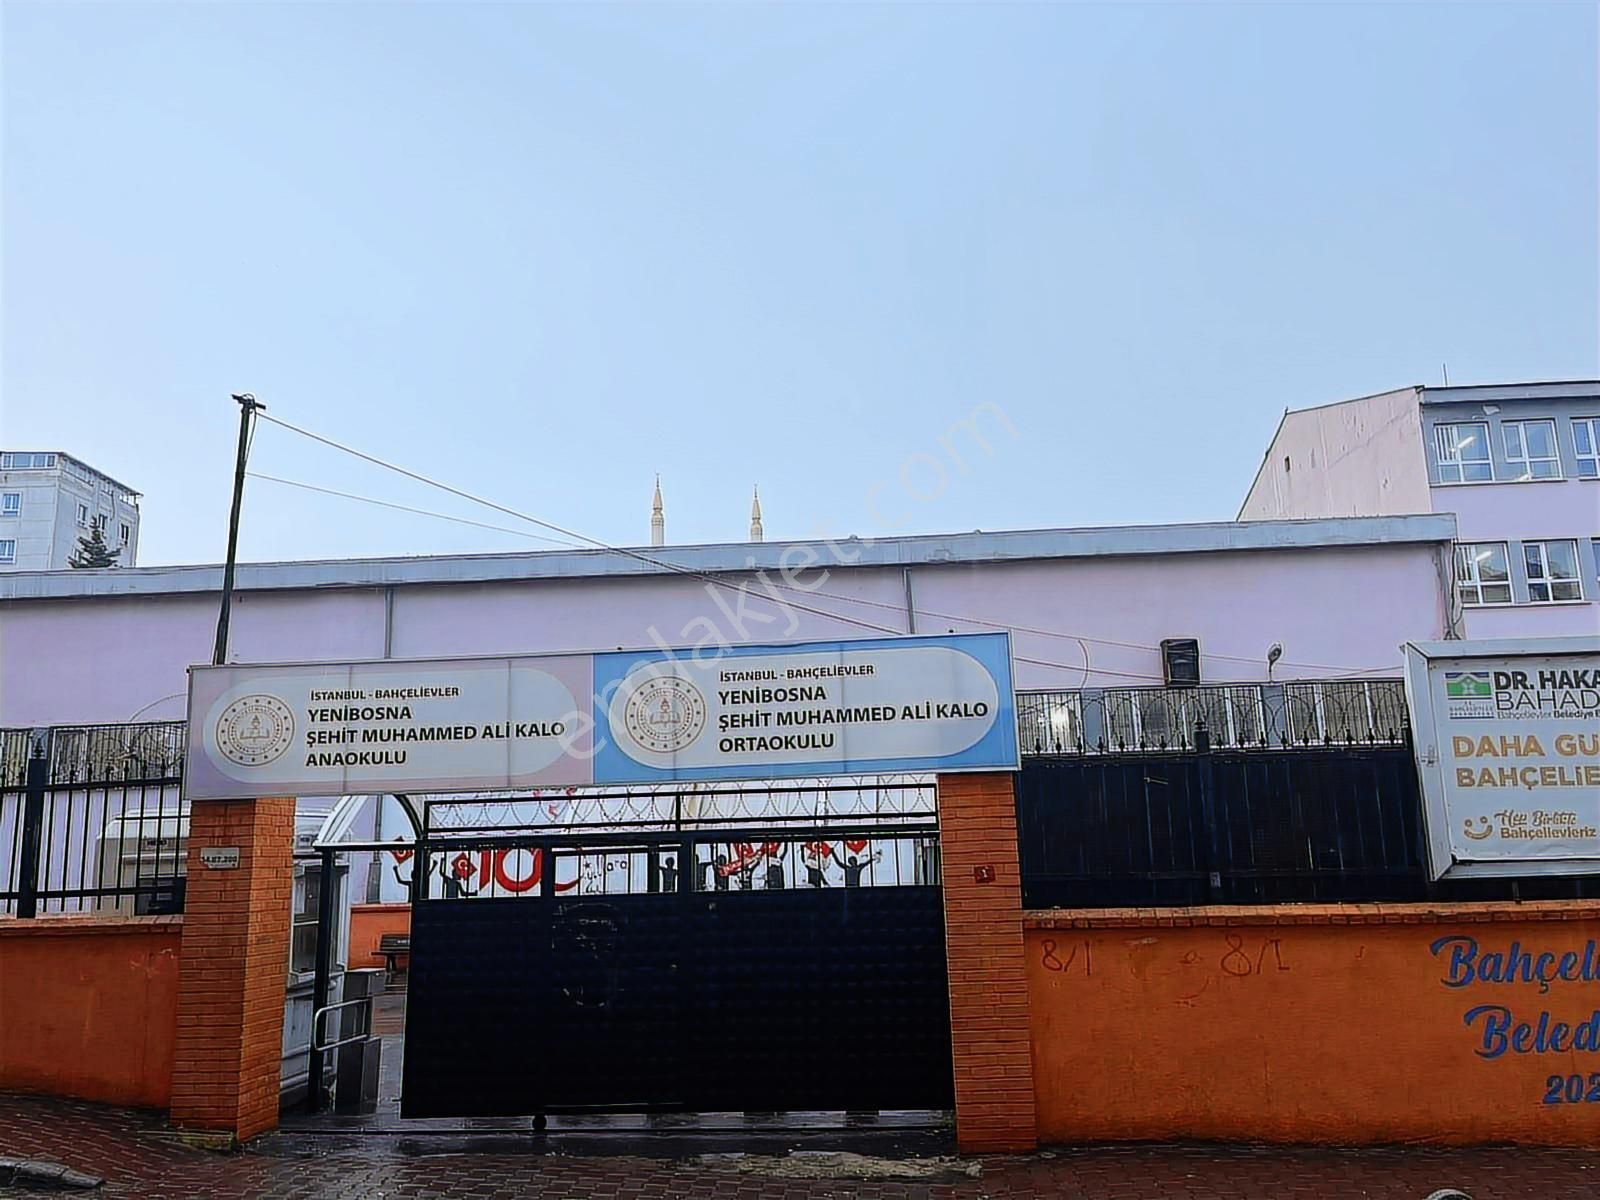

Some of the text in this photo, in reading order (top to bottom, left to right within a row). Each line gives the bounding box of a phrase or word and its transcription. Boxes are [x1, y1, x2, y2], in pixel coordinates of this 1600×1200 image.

[719, 670, 777, 683] İSTANBUL
[786, 664, 875, 681] BAHÇELİEVLER
[1493, 671, 1535, 690] DR.
[310, 687, 367, 701] İSTANBUL
[375, 686, 460, 701] BAHÇELİEVLER
[718, 685, 826, 706] YENİBOSNA
[1494, 689, 1600, 711] BAHAD
[307, 704, 412, 723] YENİBOSNA
[718, 711, 772, 733] ŞEHİT
[776, 706, 896, 728] MUHAMMED
[900, 701, 931, 721] ALİ
[936, 702, 989, 719] KALO
[306, 720, 565, 748] ŞEHİT MUHAMMED ALİ KALO
[718, 732, 835, 753] ORTAOKULU
[1452, 734, 1600, 758] DAHA GÜ
[305, 750, 407, 768] ANAOKULU
[1429, 935, 1600, 995] Bahçel
[1463, 1004, 1600, 1060] Beled
[1542, 1072, 1600, 1105] 202
